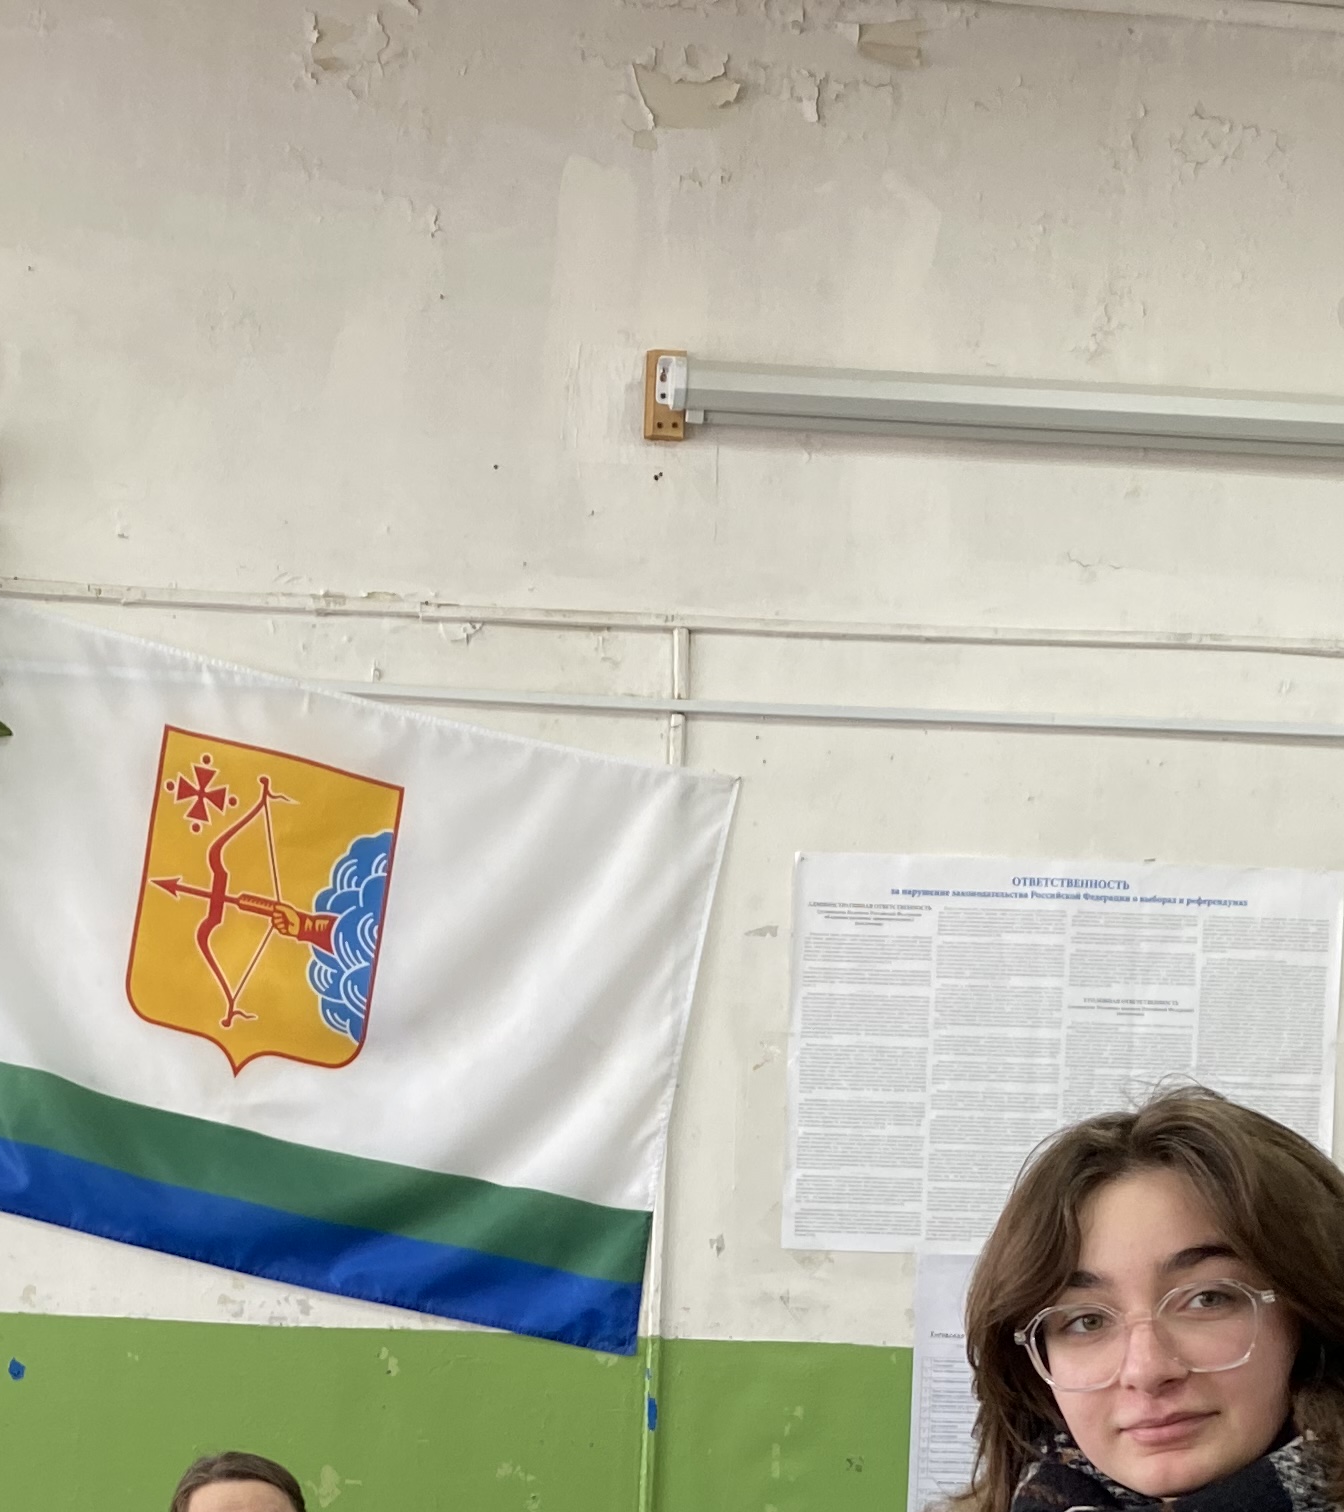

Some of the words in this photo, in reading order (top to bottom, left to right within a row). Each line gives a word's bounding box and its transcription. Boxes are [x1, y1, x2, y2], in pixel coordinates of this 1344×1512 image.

[1012, 876, 1130, 890] ОТВЕТСТВЕННОСТЬ
[902, 888, 950, 898] нарушение
[952, 889, 1028, 899] законодательства
[1030, 890, 1081, 900] Российской
[1083, 892, 1131, 903] Федерации
[1186, 896, 1248, 908] референдумах
